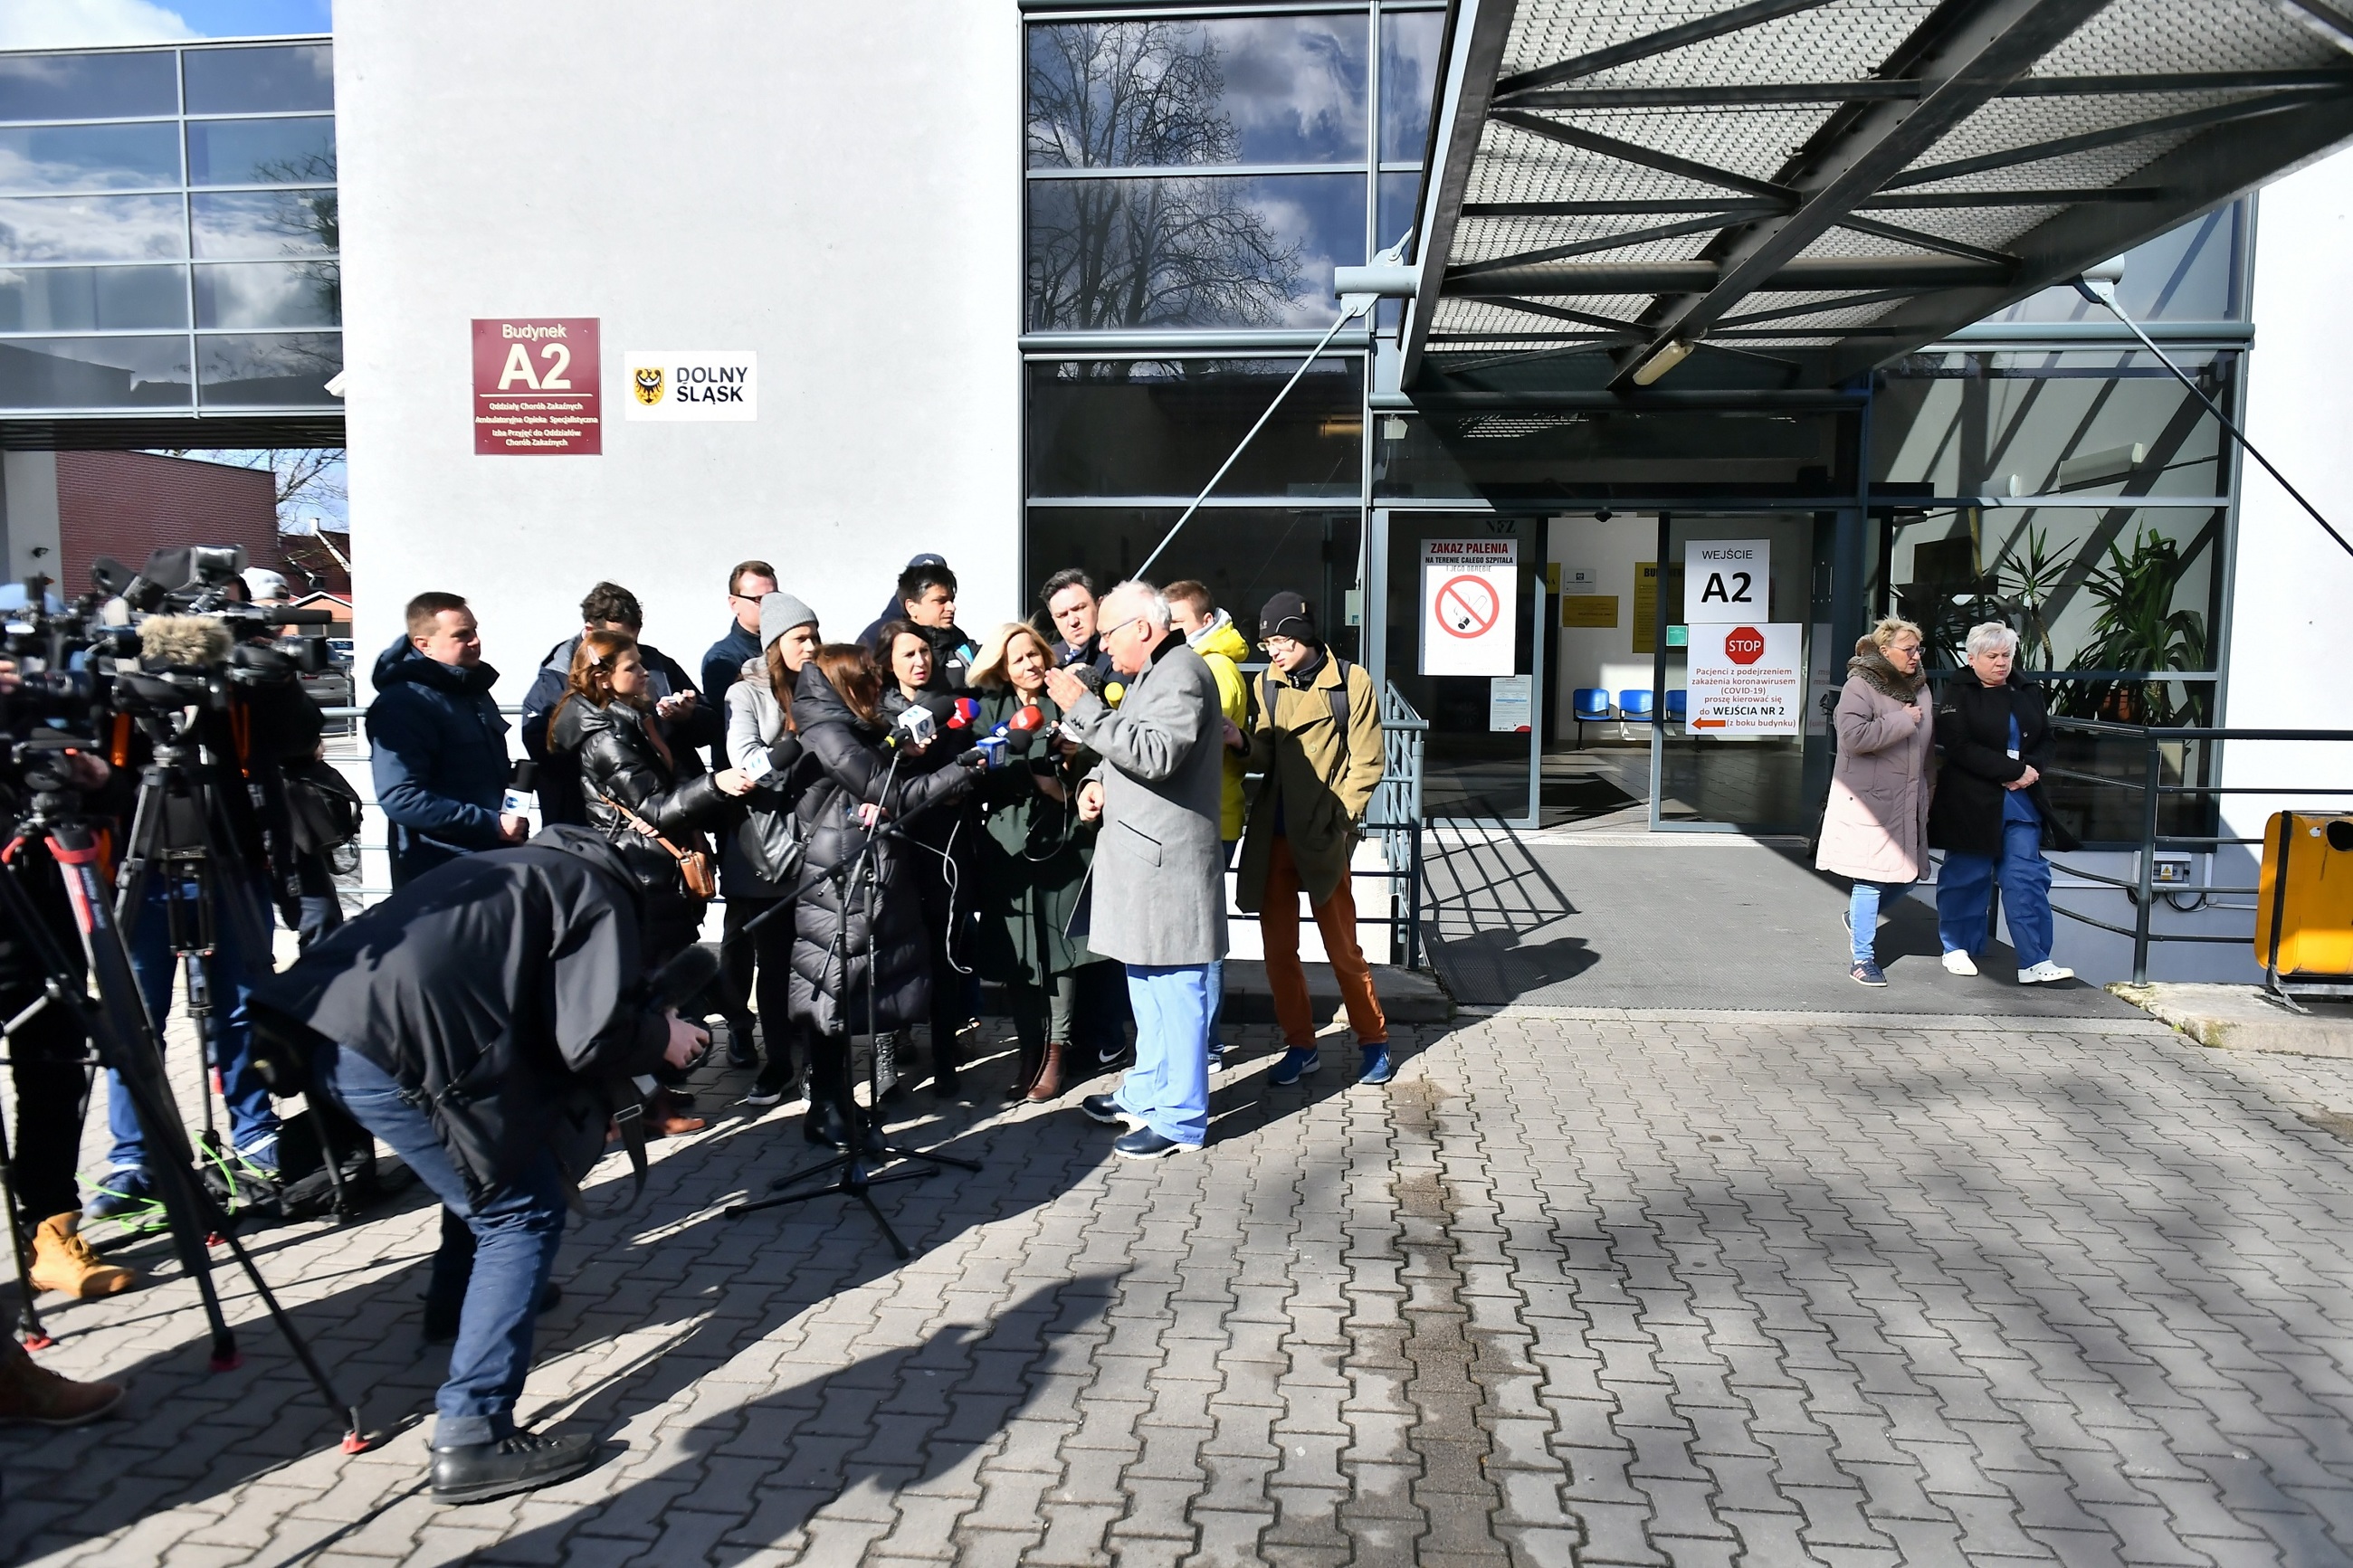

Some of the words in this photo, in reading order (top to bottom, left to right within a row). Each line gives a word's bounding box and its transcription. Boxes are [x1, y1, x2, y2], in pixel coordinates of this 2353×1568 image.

[502, 323, 567, 342] Budynek
[497, 343, 571, 390] A2
[676, 366, 748, 383] DOLNY
[676, 382, 744, 404] ŚLĄSK
[489, 403, 519, 412] Oddziały
[547, 403, 583, 412] Zakaźnych
[475, 416, 523, 424] Ambulatoryjna
[524, 416, 548, 424] Opieka
[549, 416, 598, 424] Specjalistyczna
[508, 429, 532, 438] Przyjęć
[532, 439, 568, 447] Zakaźnych
[1431, 543, 1463, 554] ZAKAZ
[1466, 543, 1509, 554] PALENIA
[1701, 548, 1753, 560] WEJŚCIE
[1700, 572, 1752, 603] A2
[1729, 640, 1761, 652] STOP
[1696, 668, 1729, 677] Pacjenci
[1737, 668, 1792, 677] podejrzeniem
[1720, 687, 1766, 696] (COVID-19)
[1704, 696, 1730, 704] proszę
[1732, 695, 1768, 703] kierować
[1771, 696, 1782, 704] się
[1713, 705, 1758, 715] WEJŚCIA
[1760, 707, 1776, 715] NR
[1778, 707, 1785, 715] 2
[1727, 719, 1734, 727] (z
[1758, 719, 1796, 727] budynku)
